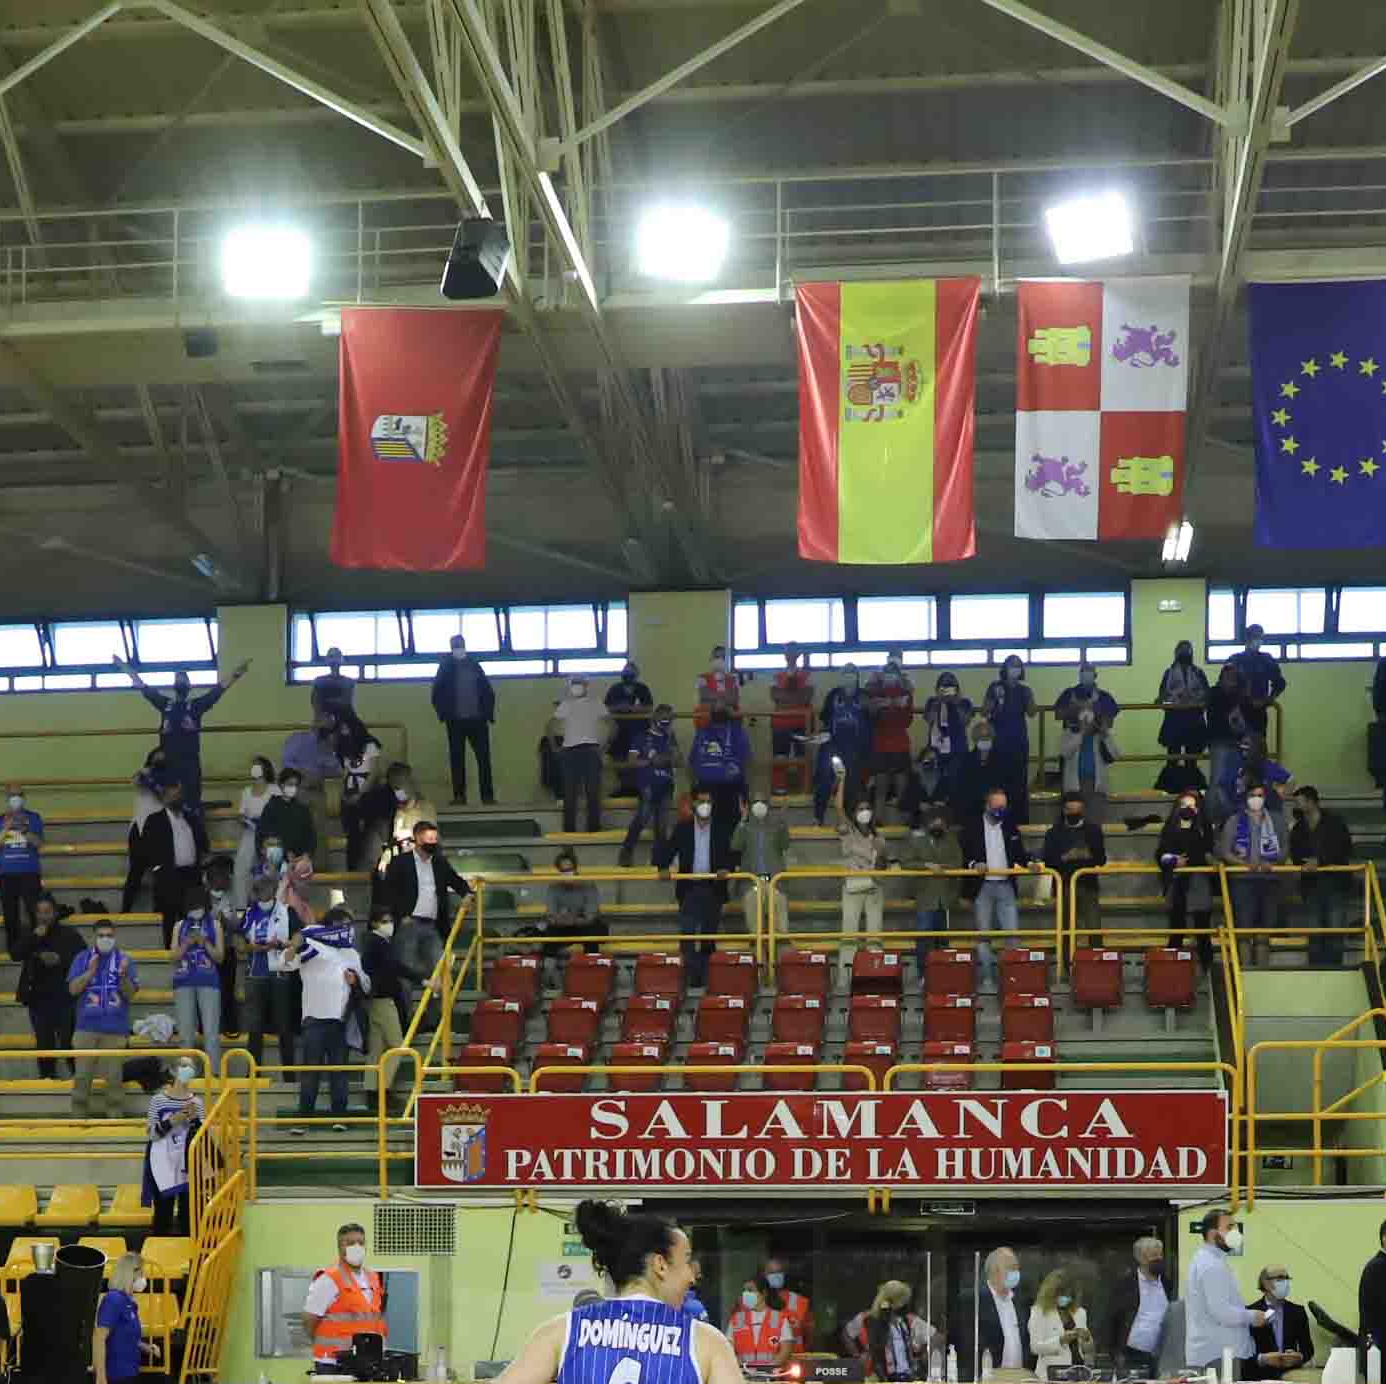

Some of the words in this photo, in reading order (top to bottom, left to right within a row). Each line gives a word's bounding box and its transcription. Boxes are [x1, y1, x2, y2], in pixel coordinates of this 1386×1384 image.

[589, 1098, 1134, 1140] SALAMANCA
[504, 1146, 777, 1181] PATRIMONIO
[790, 1147, 851, 1180] DE
[866, 1147, 926, 1180] LA
[935, 1146, 1208, 1180] HUMANIDAD
[578, 1313, 682, 1357] DOMÍNGUEZ
[815, 1367, 848, 1377] POSSE
